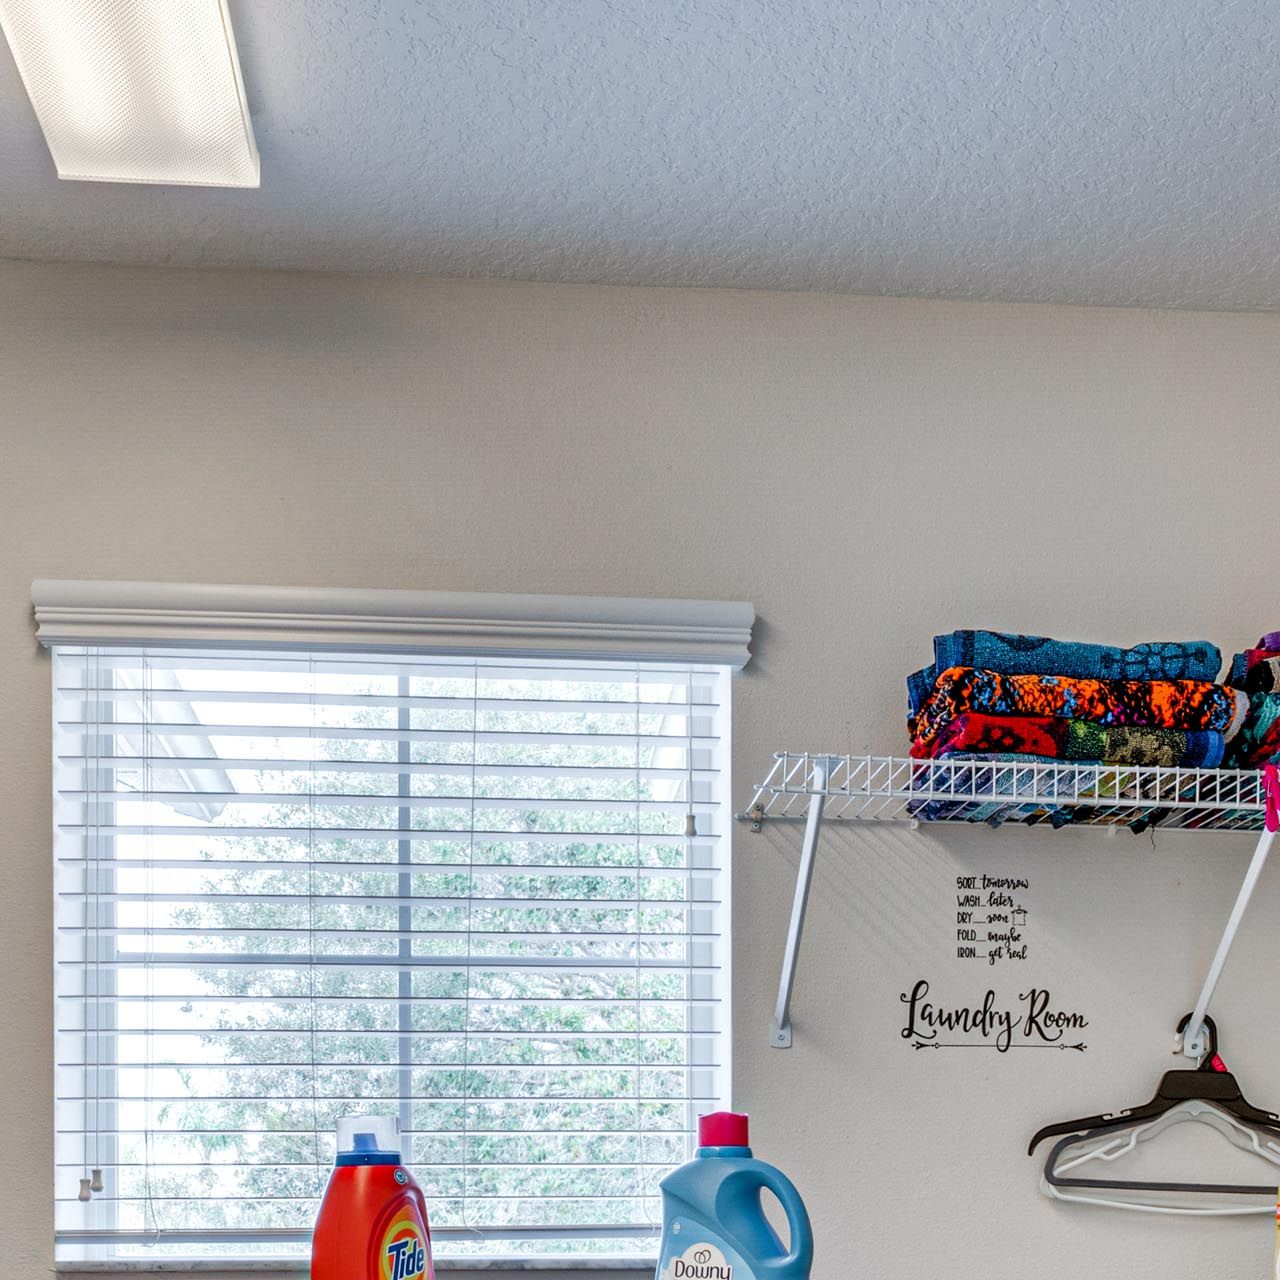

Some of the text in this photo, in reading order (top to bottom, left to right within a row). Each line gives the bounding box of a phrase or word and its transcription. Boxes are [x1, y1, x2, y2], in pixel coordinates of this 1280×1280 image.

[980, 873, 1029, 890] tomorrow
[986, 891, 1014, 907] later
[986, 913, 1009, 924] soon
[987, 926, 1022, 948] maybe
[988, 945, 1005, 966] get
[1006, 944, 1028, 960] real
[900, 980, 1089, 1053] Laundry Room
